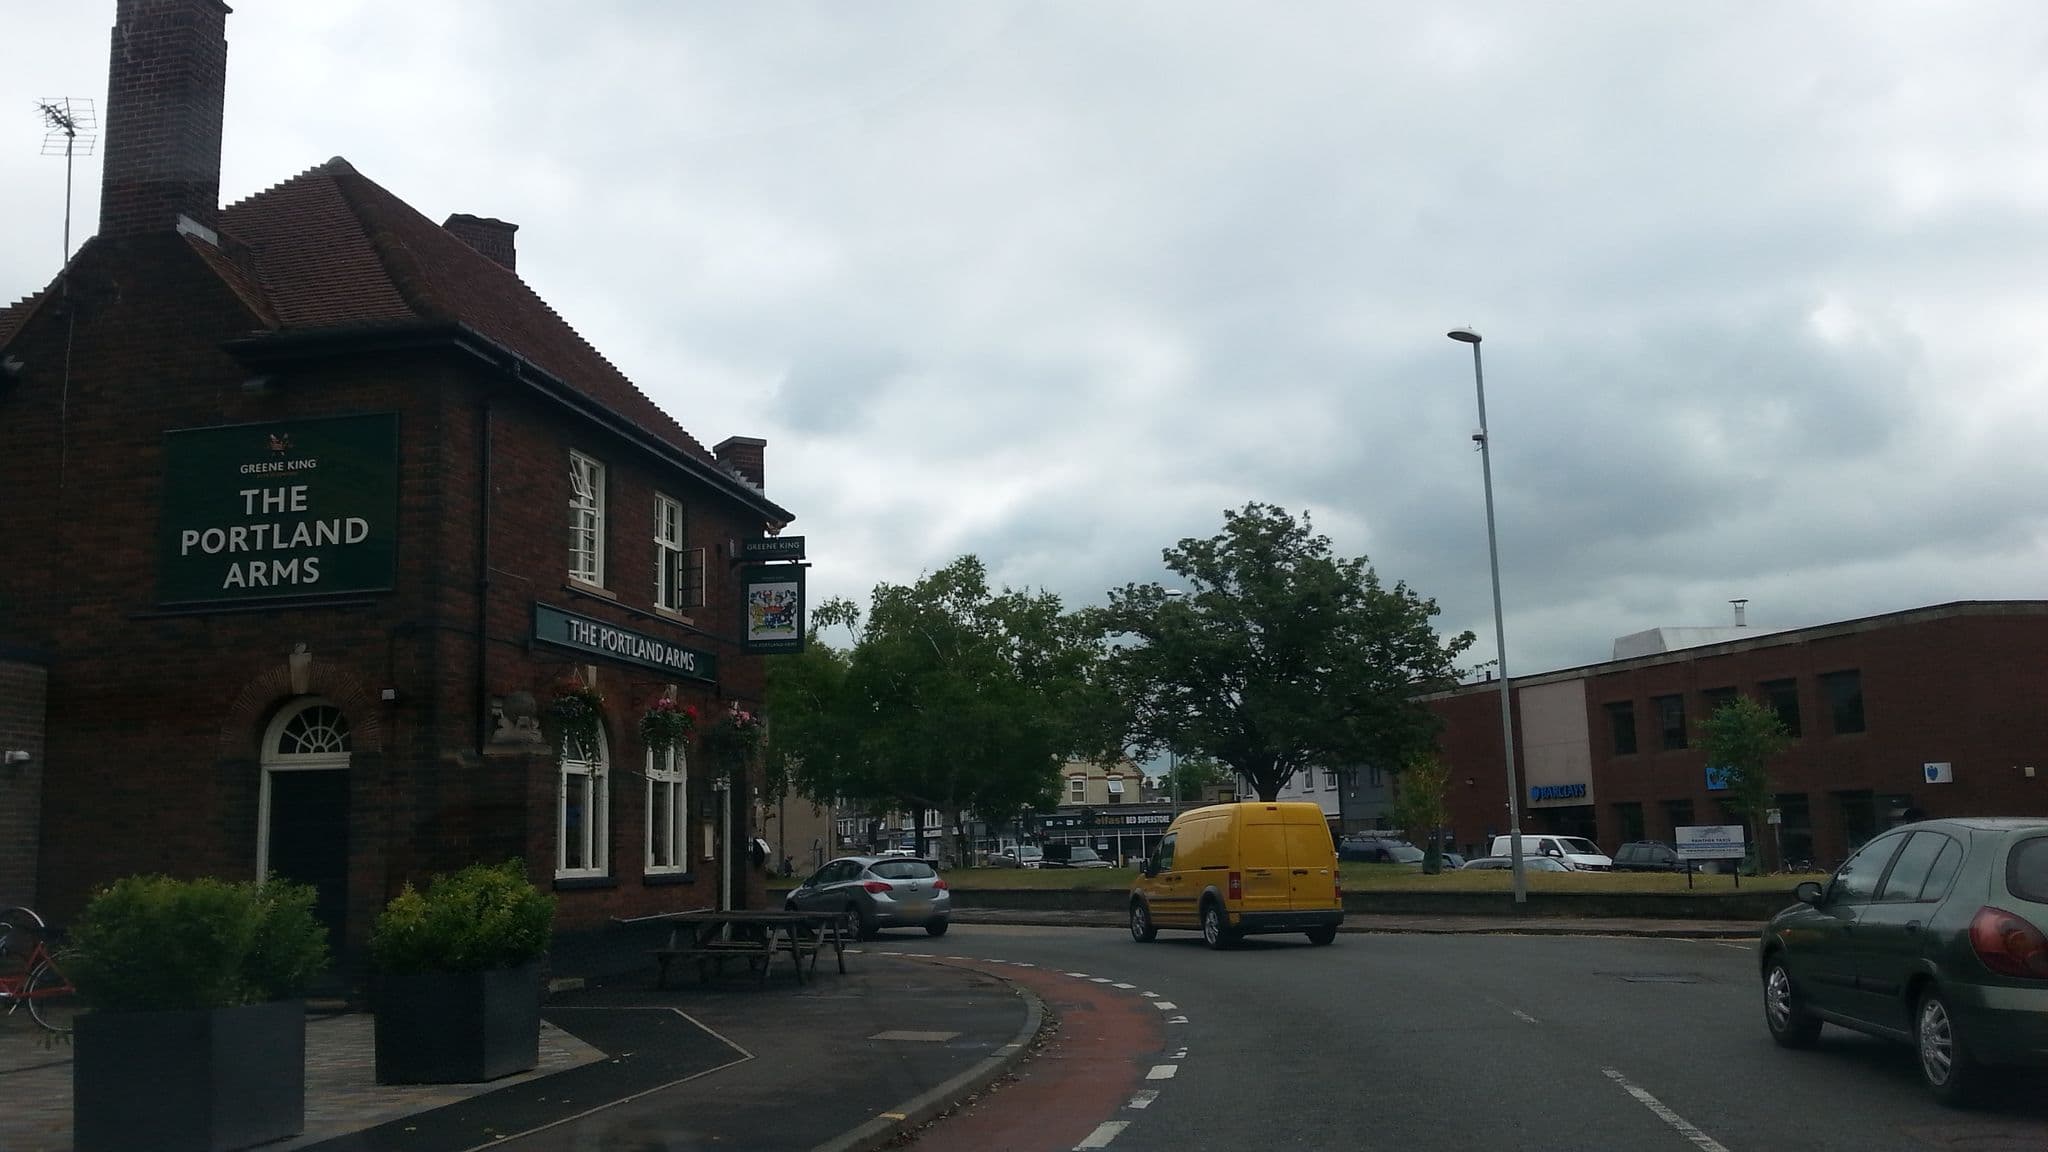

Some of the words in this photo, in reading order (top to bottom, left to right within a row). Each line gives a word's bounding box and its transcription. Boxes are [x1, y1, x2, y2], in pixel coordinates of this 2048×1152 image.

[240, 462, 284, 474] GREENE
[287, 459, 317, 471] KING
[240, 485, 308, 515] THE
[181, 517, 369, 556] PORTLAND
[746, 543, 777, 551] GREENE
[780, 541, 800, 549] KING
[222, 557, 320, 589] ARMS
[570, 620, 597, 646] THE
[601, 627, 664, 663] PORTLAND
[665, 646, 695, 672] ARMS
[1540, 784, 1586, 798] BARCLAYS
[1138, 815, 1170, 824] SUPERSTORE
